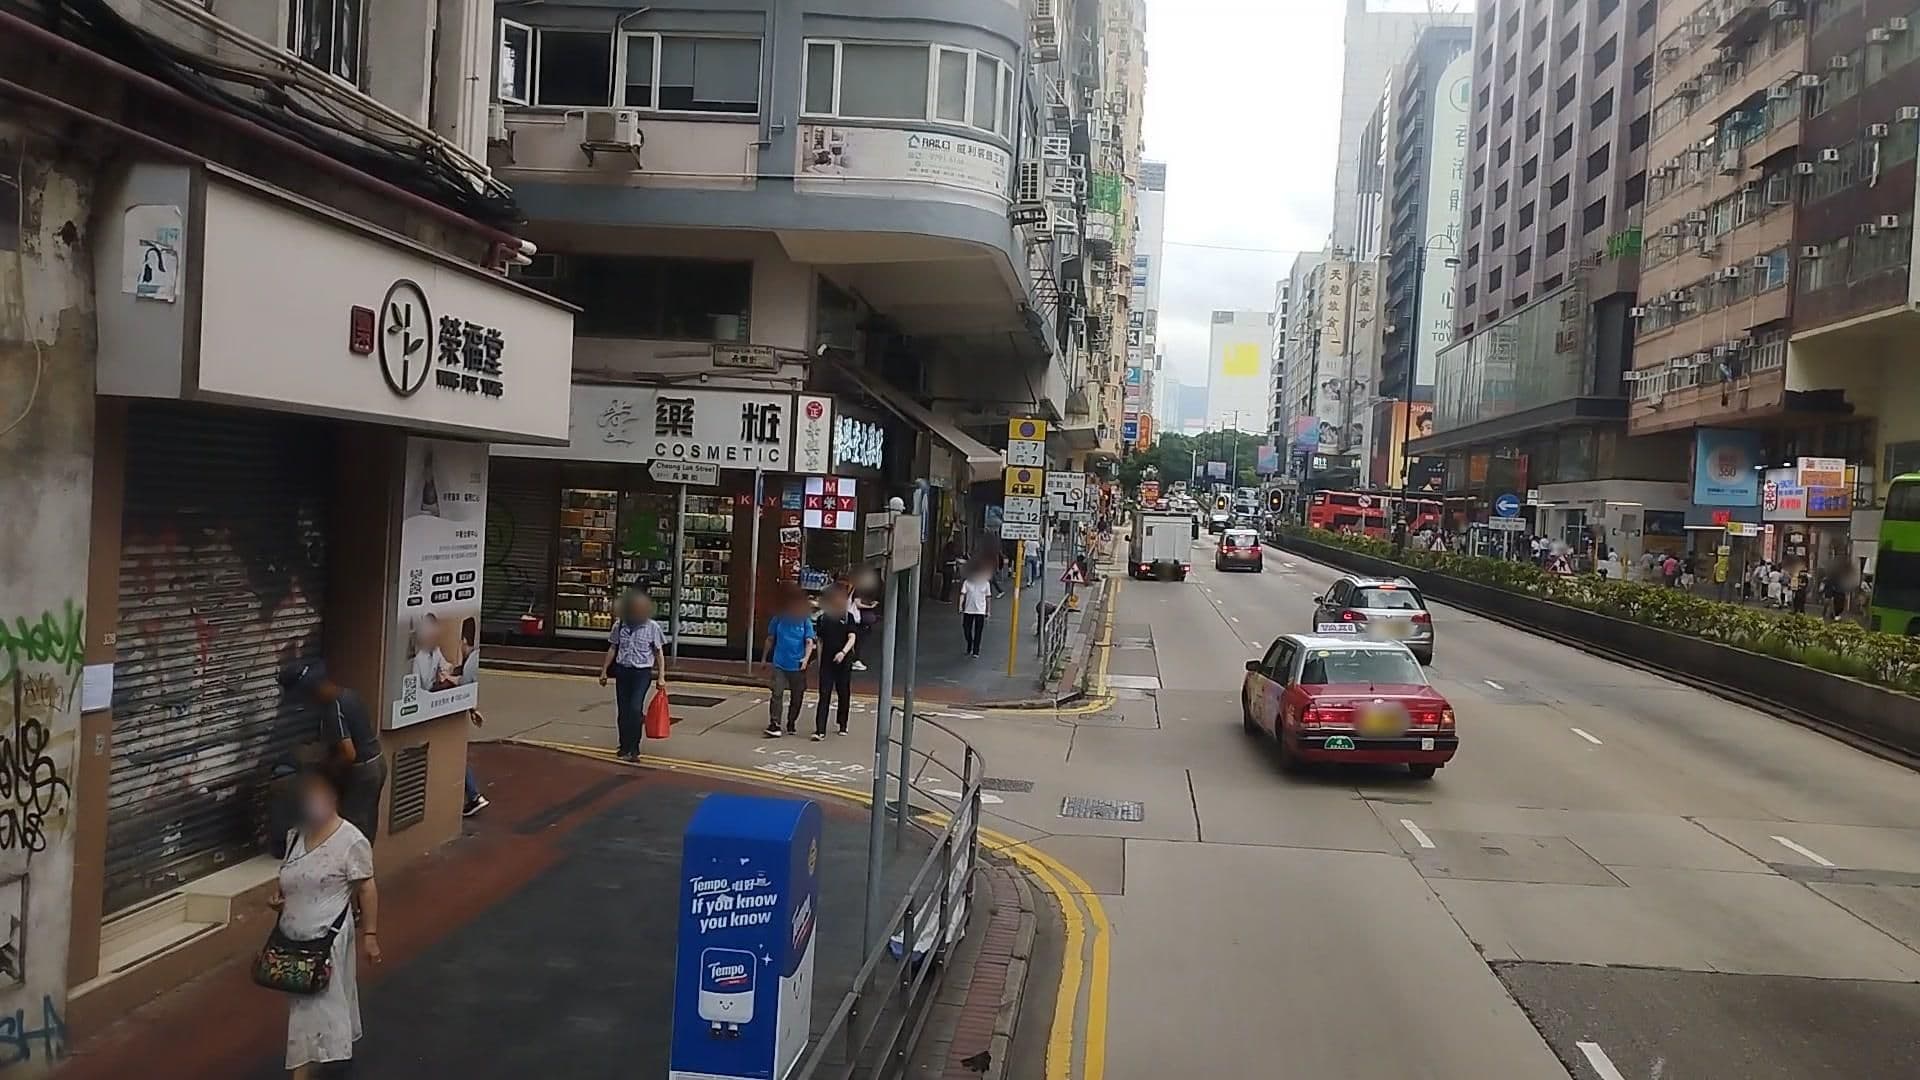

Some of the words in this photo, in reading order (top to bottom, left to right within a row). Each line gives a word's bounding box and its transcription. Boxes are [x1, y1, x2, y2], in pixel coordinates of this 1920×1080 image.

[1031, 443, 1038, 452] 7
[654, 443, 782, 464] COSMETIC
[1031, 456, 1038, 465] 7
[825, 480, 836, 492] M
[741, 495, 750, 505] K
[769, 497, 777, 506] Y
[808, 497, 818, 507] K
[841, 498, 850, 508] Y
[1028, 499, 1034, 508] 7
[1027, 513, 1038, 522] 12
[690, 876, 728, 894] Tempo
[692, 898, 704, 914] If
[706, 899, 734, 916] you
[736, 894, 778, 909] know
[700, 916, 727, 934] you
[730, 911, 772, 927] know
[708, 962, 745, 979] Tempo
